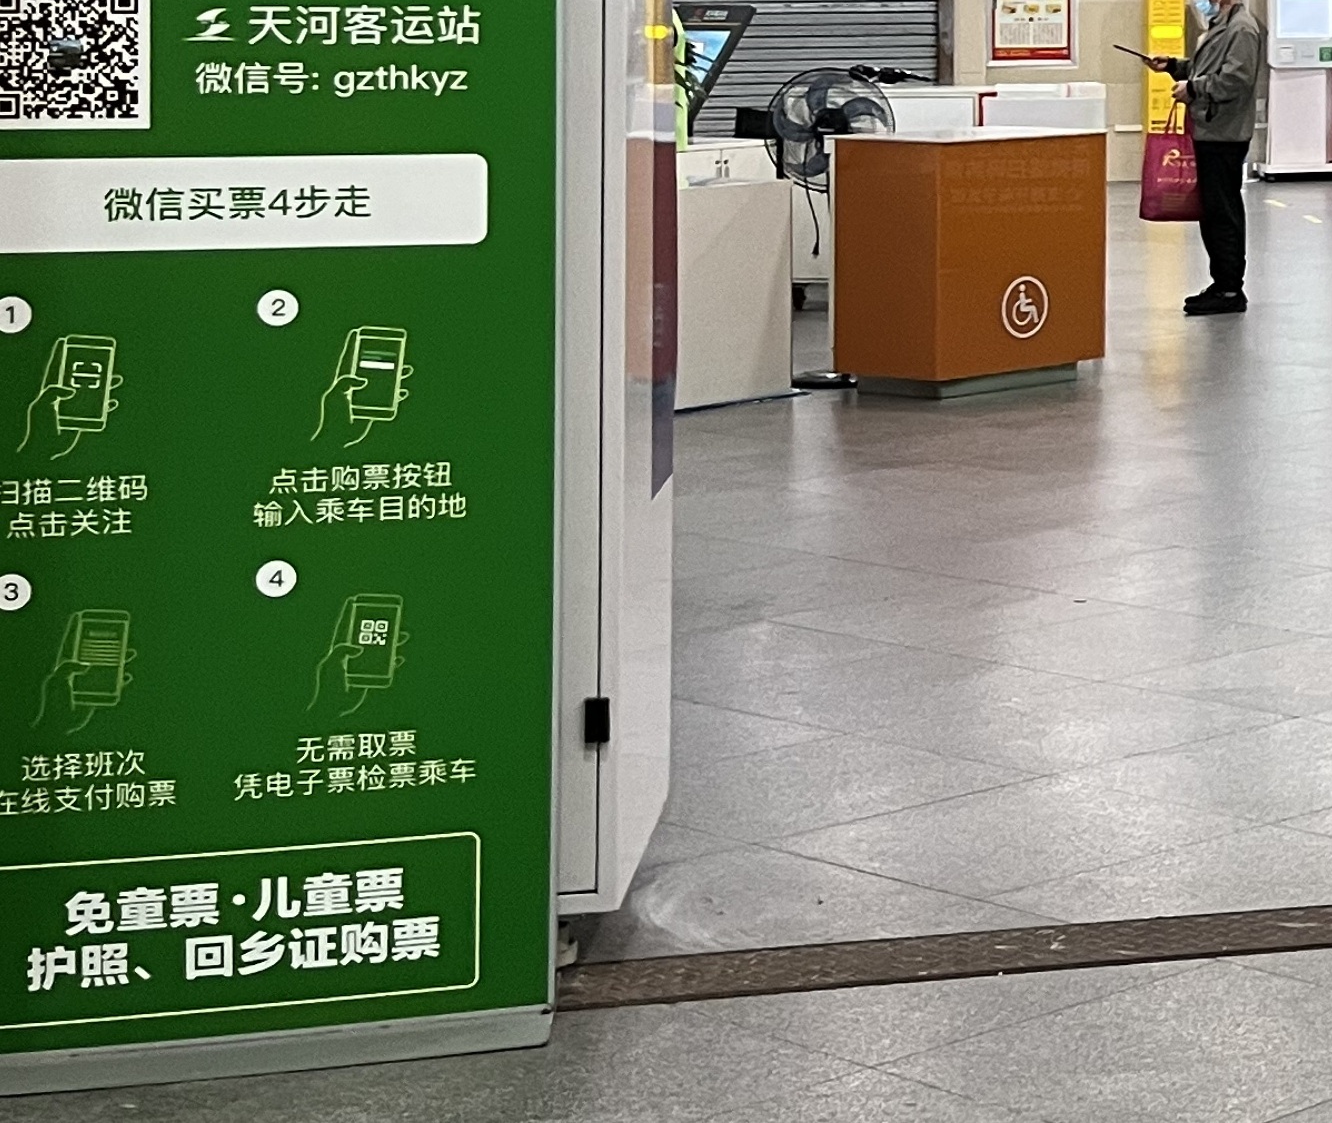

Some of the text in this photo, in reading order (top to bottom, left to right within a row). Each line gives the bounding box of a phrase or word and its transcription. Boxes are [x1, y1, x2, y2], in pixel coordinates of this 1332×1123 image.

[248, 5, 482, 46] 天河客运站
[333, 65, 469, 98] gzthkyz
[103, 184, 373, 223] 微信买票4步走
[269, 461, 454, 494] 点击购票按钮
[6, 507, 133, 539] 点击关注
[252, 493, 467, 528] 输入乘车目的地
[296, 729, 418, 765] 无需取票
[21, 749, 146, 782] 选择班次
[233, 758, 477, 801] 凭电子票检票乘车
[0, 779, 177, 816] 在线支付购票
[65, 867, 405, 936] 免童票·儿童票
